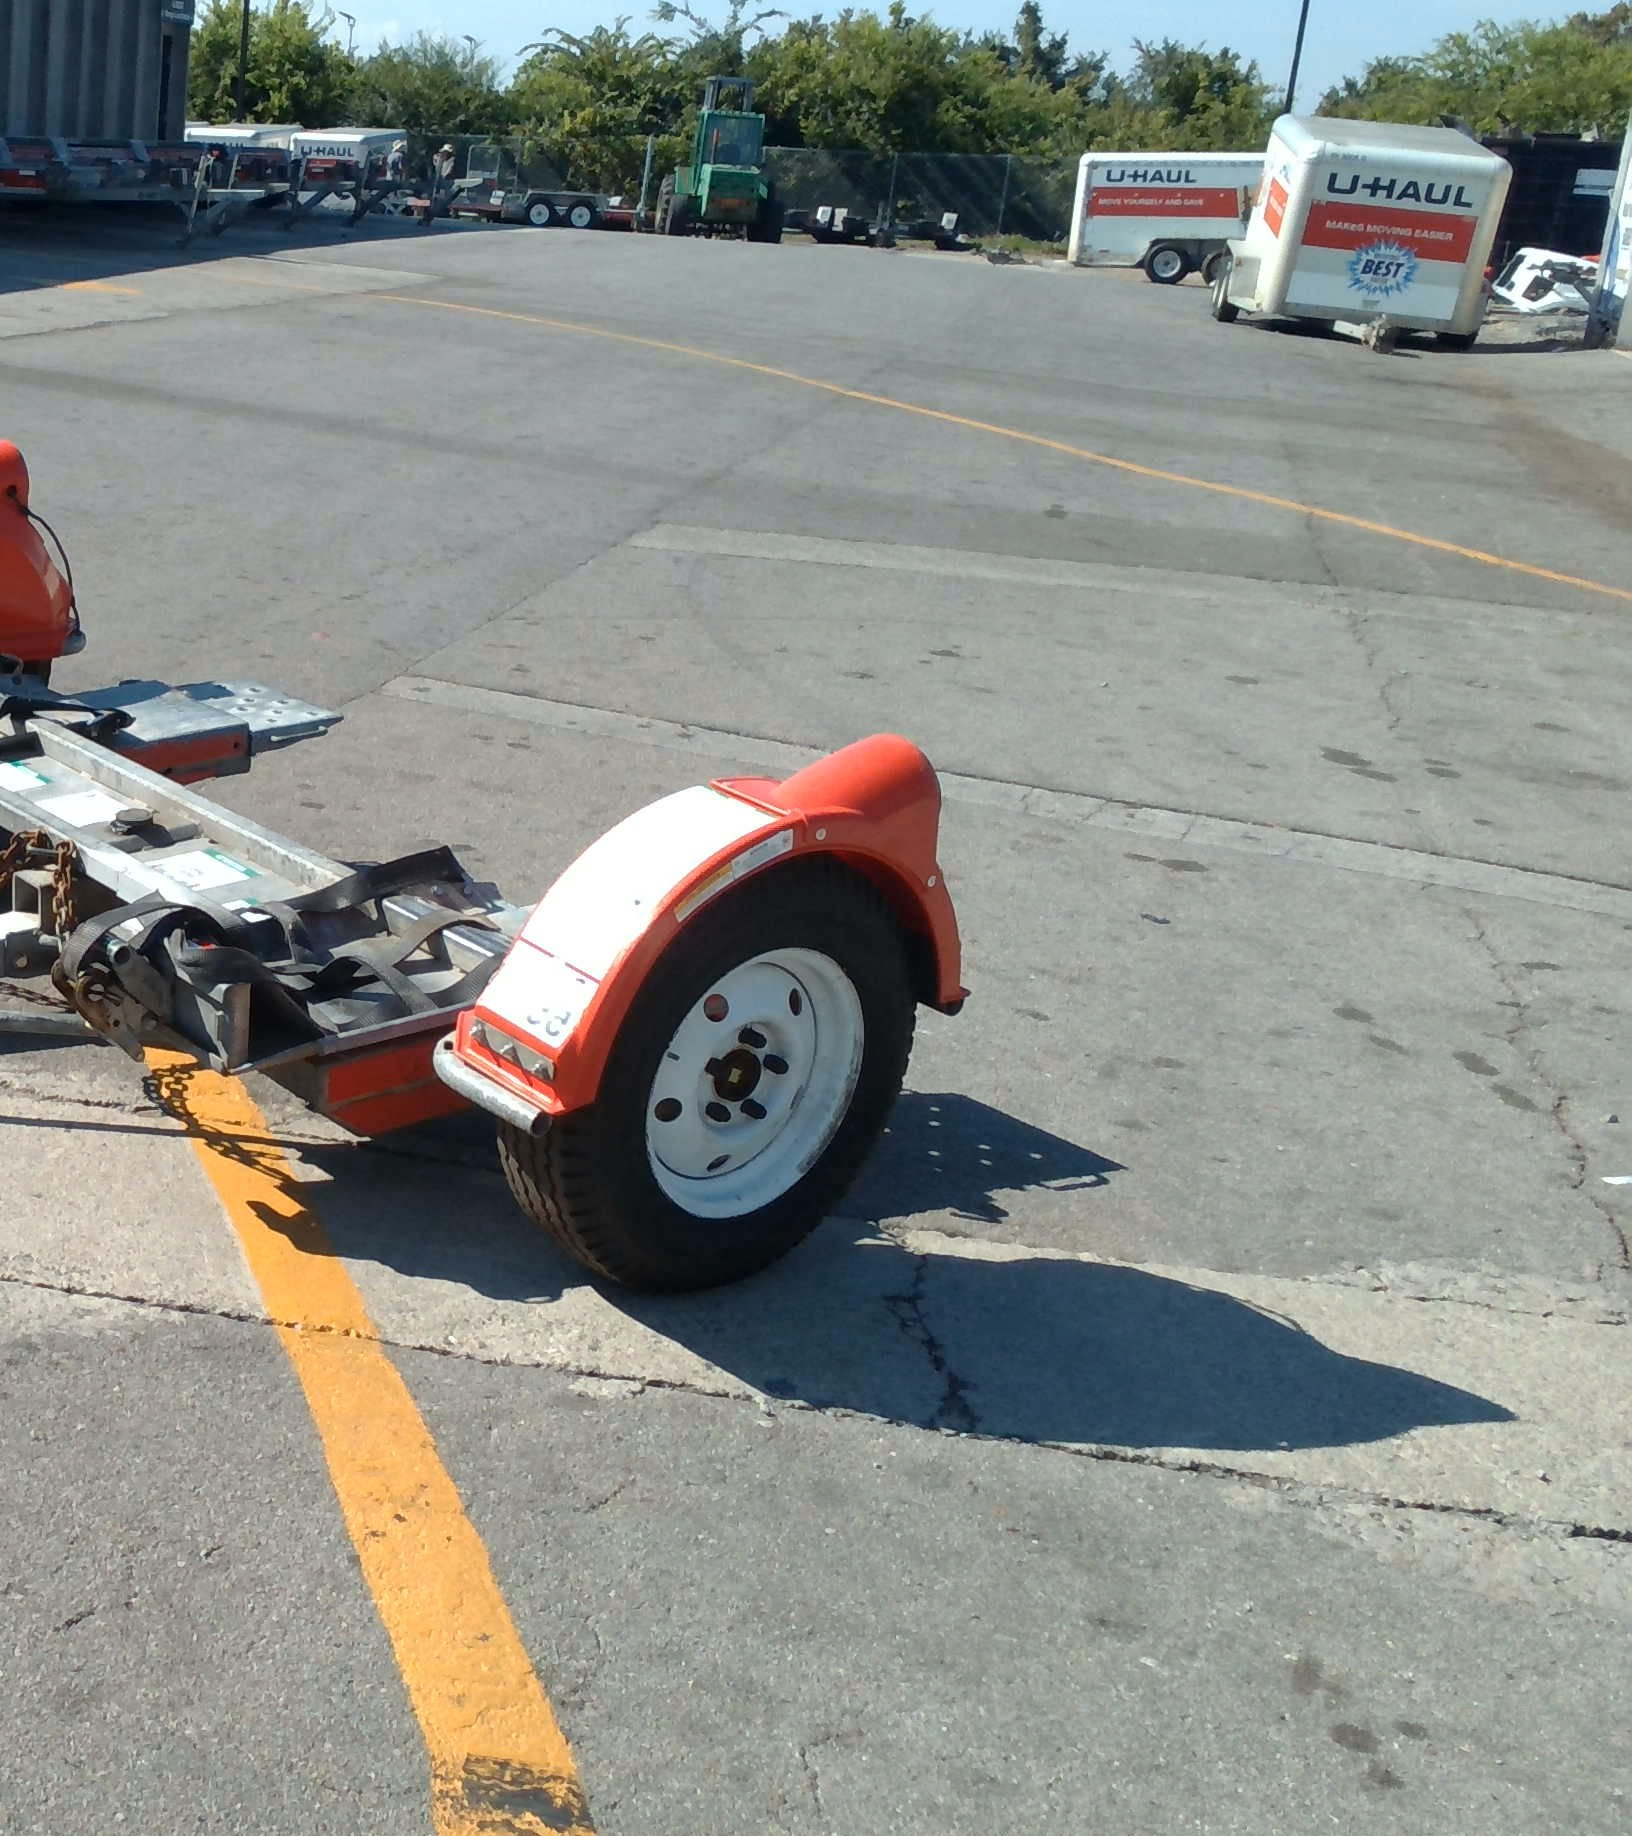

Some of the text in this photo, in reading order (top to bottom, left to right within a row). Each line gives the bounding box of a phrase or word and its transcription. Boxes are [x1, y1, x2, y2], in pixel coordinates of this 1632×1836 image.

[301, 145, 354, 157] U-HAUL
[1106, 169, 1197, 183] U-HAUL
[1327, 172, 1473, 209] U-HAUL
[1366, 224, 1412, 238] MOVING
[1413, 227, 1454, 241] EASIER
[1360, 259, 1405, 278] BEST
